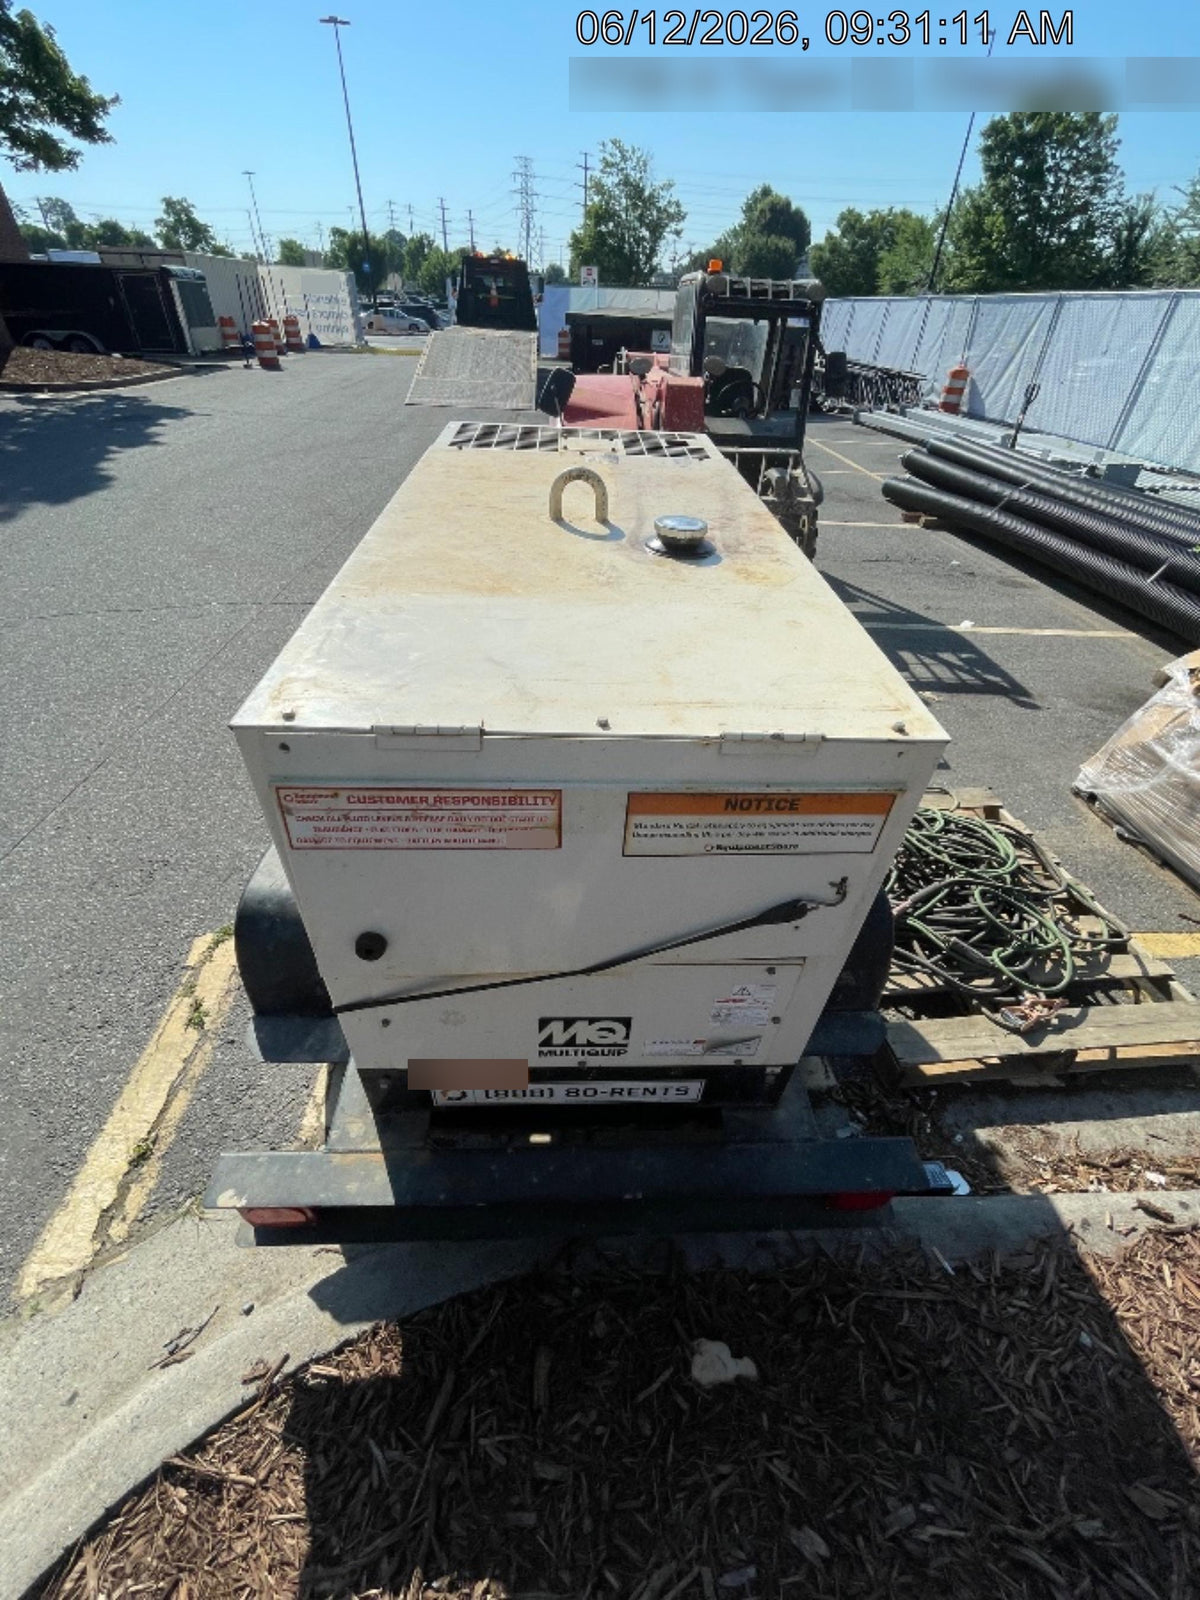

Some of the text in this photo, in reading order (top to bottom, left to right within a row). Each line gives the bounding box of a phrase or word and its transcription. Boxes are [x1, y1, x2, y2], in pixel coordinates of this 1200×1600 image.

[346, 795, 429, 805] CUSTOMER
[433, 795, 558, 807] RESPONSIBILITY
[723, 797, 800, 811] NOTICE
[538, 1018, 632, 1047] MQ
[538, 1048, 629, 1058] MULTIQUIP
[564, 1086, 690, 1098] 80-RENTS
